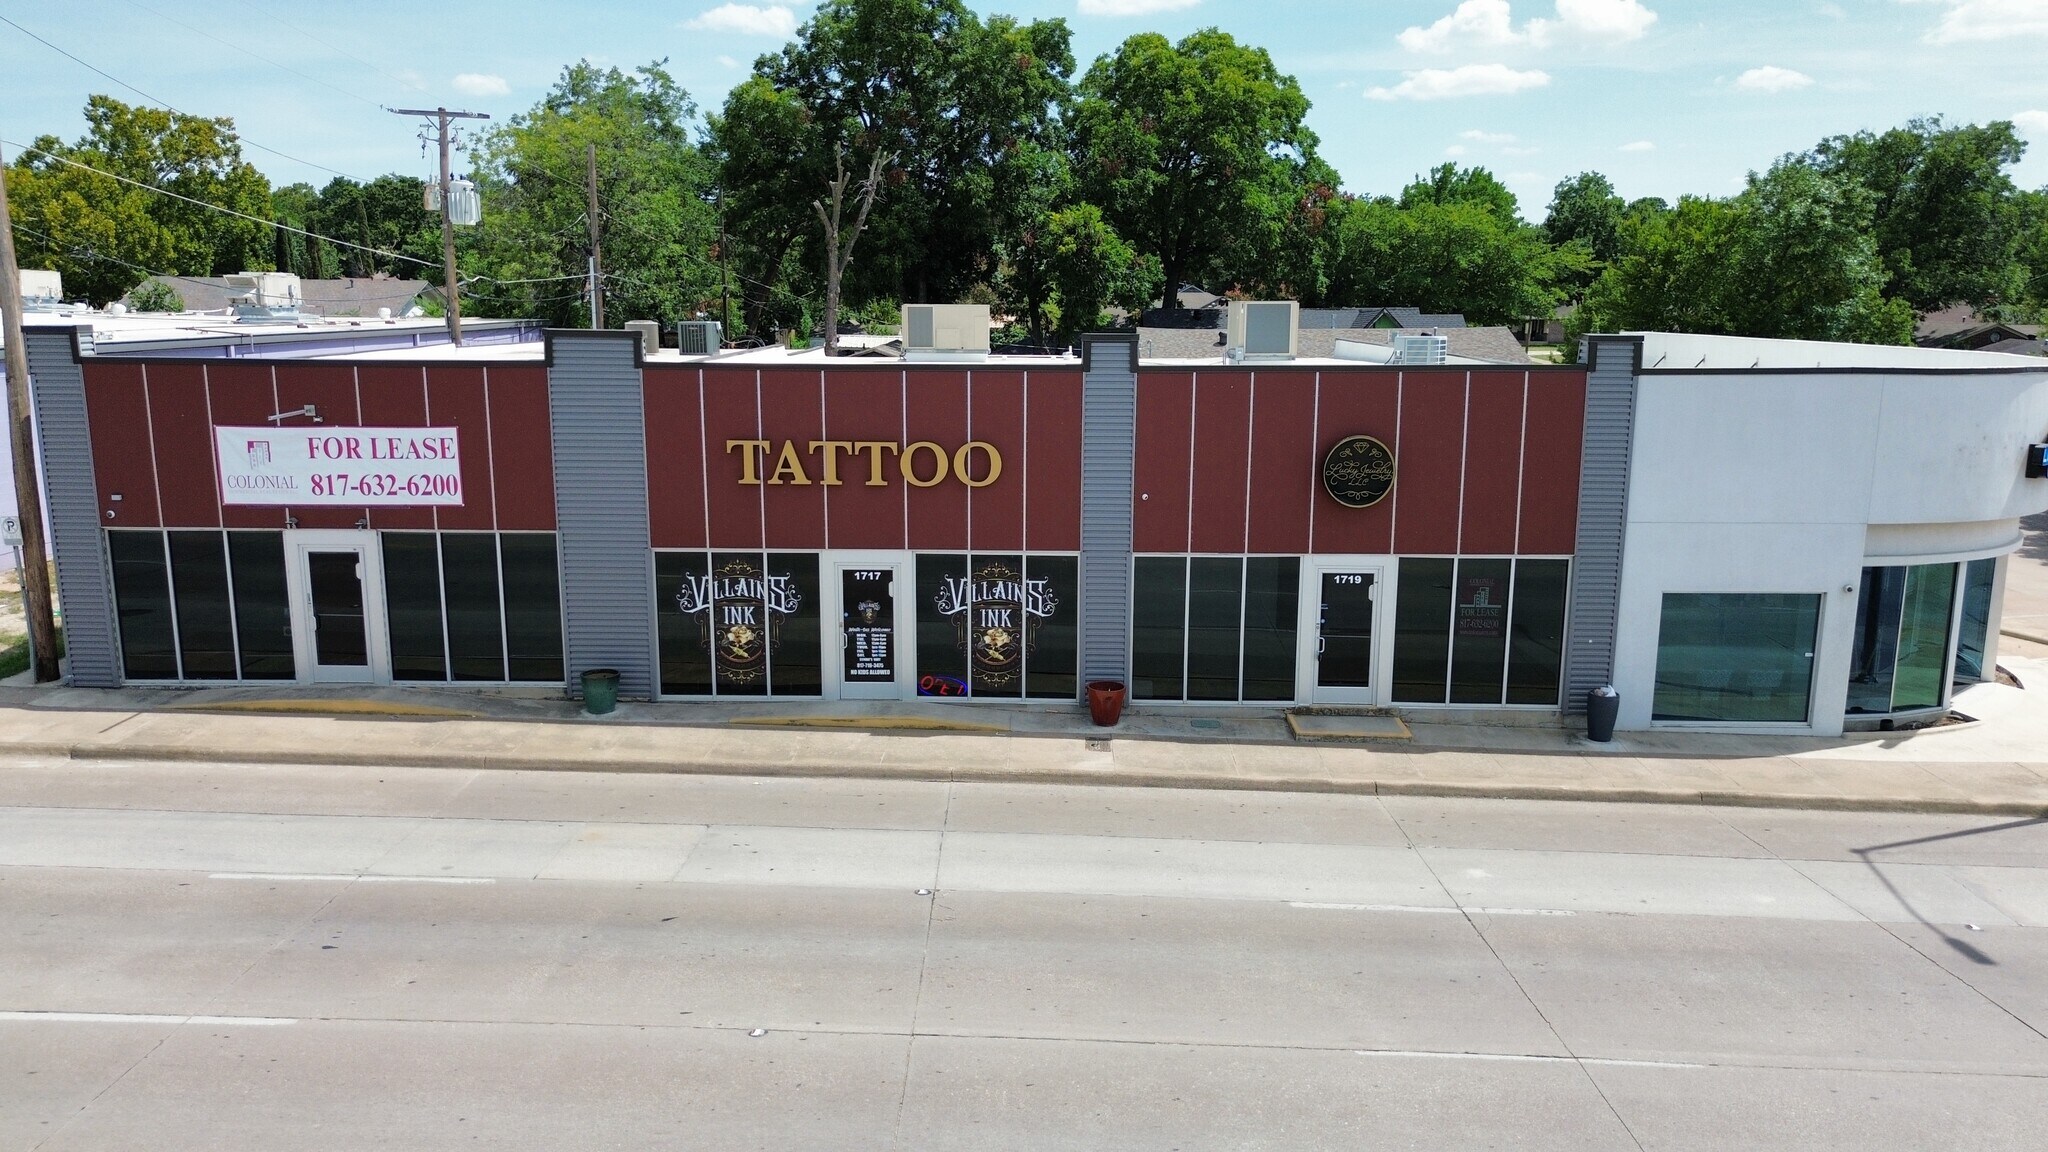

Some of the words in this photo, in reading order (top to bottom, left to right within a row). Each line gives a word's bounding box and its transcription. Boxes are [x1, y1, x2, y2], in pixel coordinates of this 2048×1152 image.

[307, 436, 363, 460] FOR
[370, 437, 456, 460] LEASE
[726, 439, 1002, 487] TATTOO
[227, 475, 299, 489] COLONIAL
[1326, 461, 1359, 485] Lucky
[1348, 478, 1369, 486] LLC
[310, 473, 459, 497] 817-632-6200
[854, 571, 882, 581] 1717
[1333, 575, 1362, 584] 1719
[676, 572, 801, 613] VLLAINS
[723, 606, 755, 625] INK
[980, 609, 1012, 628] INK
